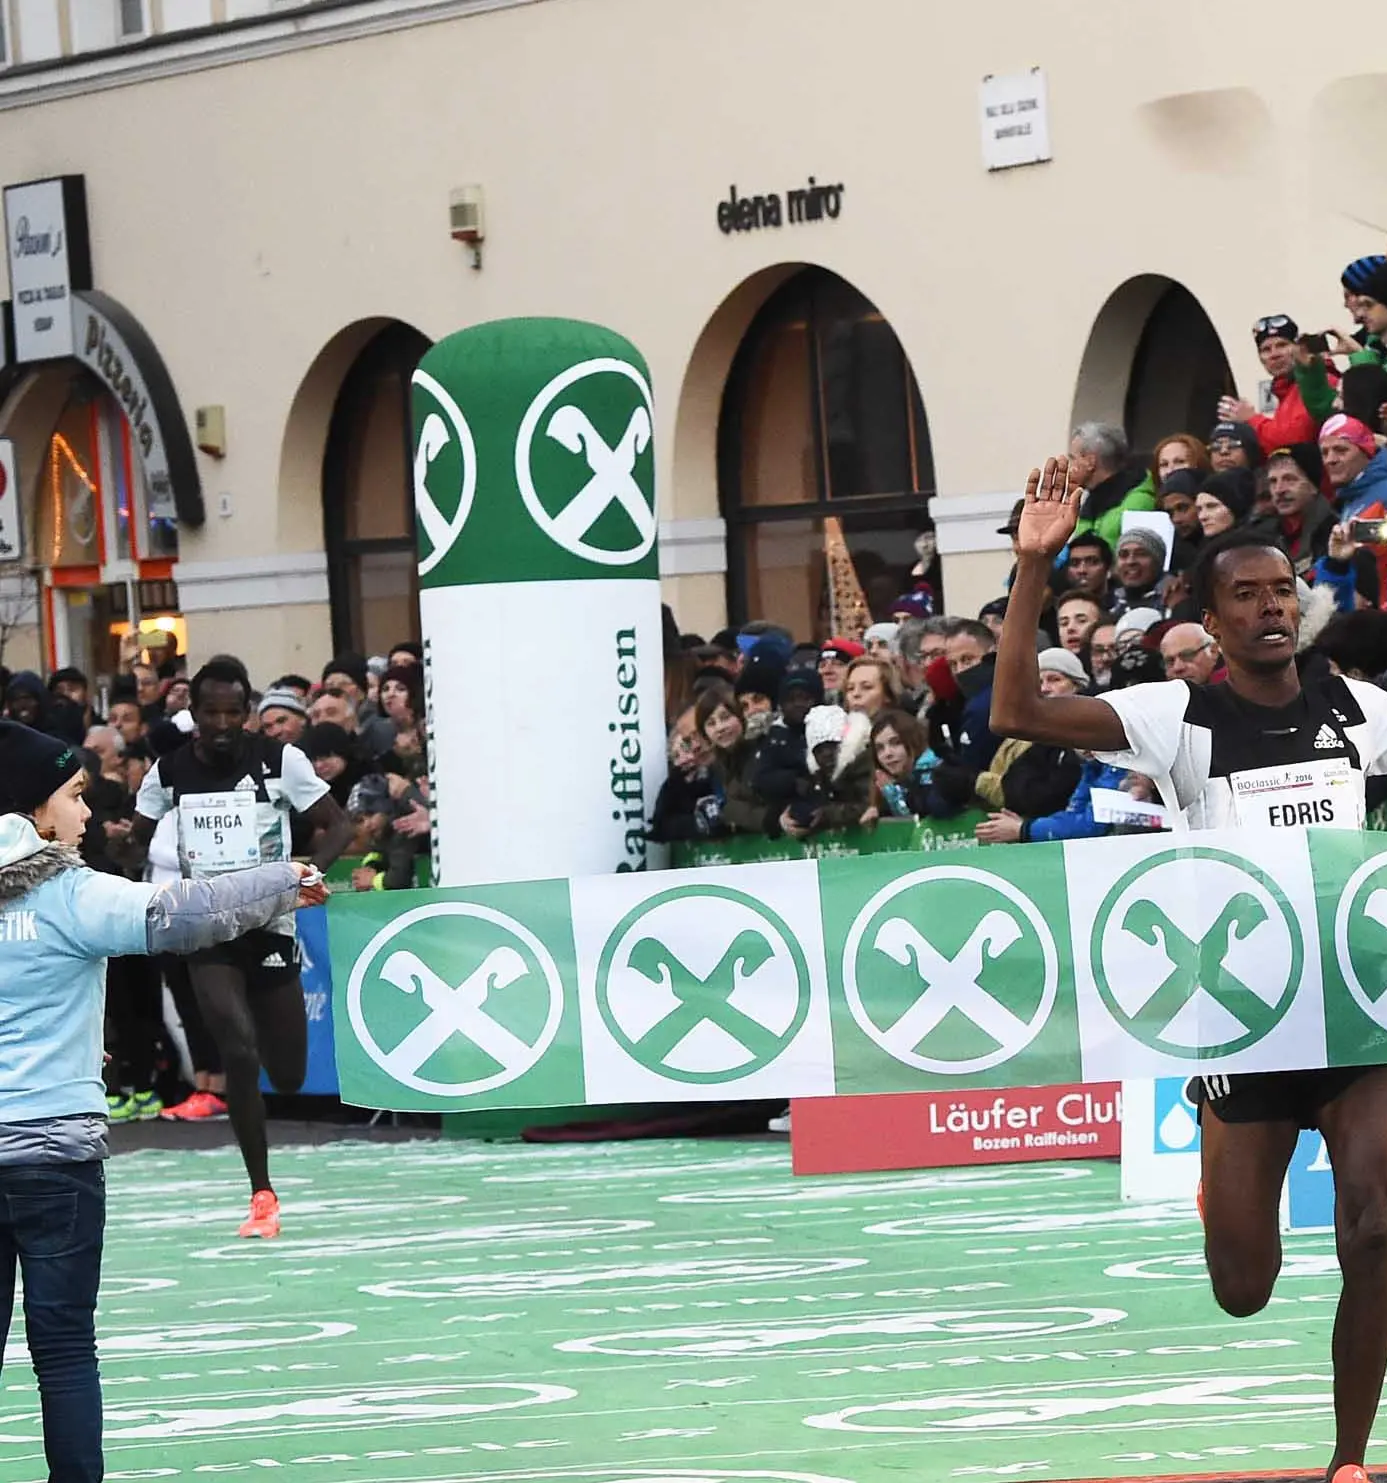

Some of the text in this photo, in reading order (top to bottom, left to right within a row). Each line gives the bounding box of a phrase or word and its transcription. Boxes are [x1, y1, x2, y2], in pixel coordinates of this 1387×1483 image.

[717, 183, 782, 234] elena
[608, 626, 648, 874] aiffeisen
[1295, 773, 1313, 783] 2016
[193, 814, 243, 829] MERGA
[1268, 799, 1334, 827] EDRIS
[214, 831, 224, 845] 5
[929, 1098, 1044, 1134] Läufer
[973, 1131, 1098, 1151] Bozen Raiffeisen
